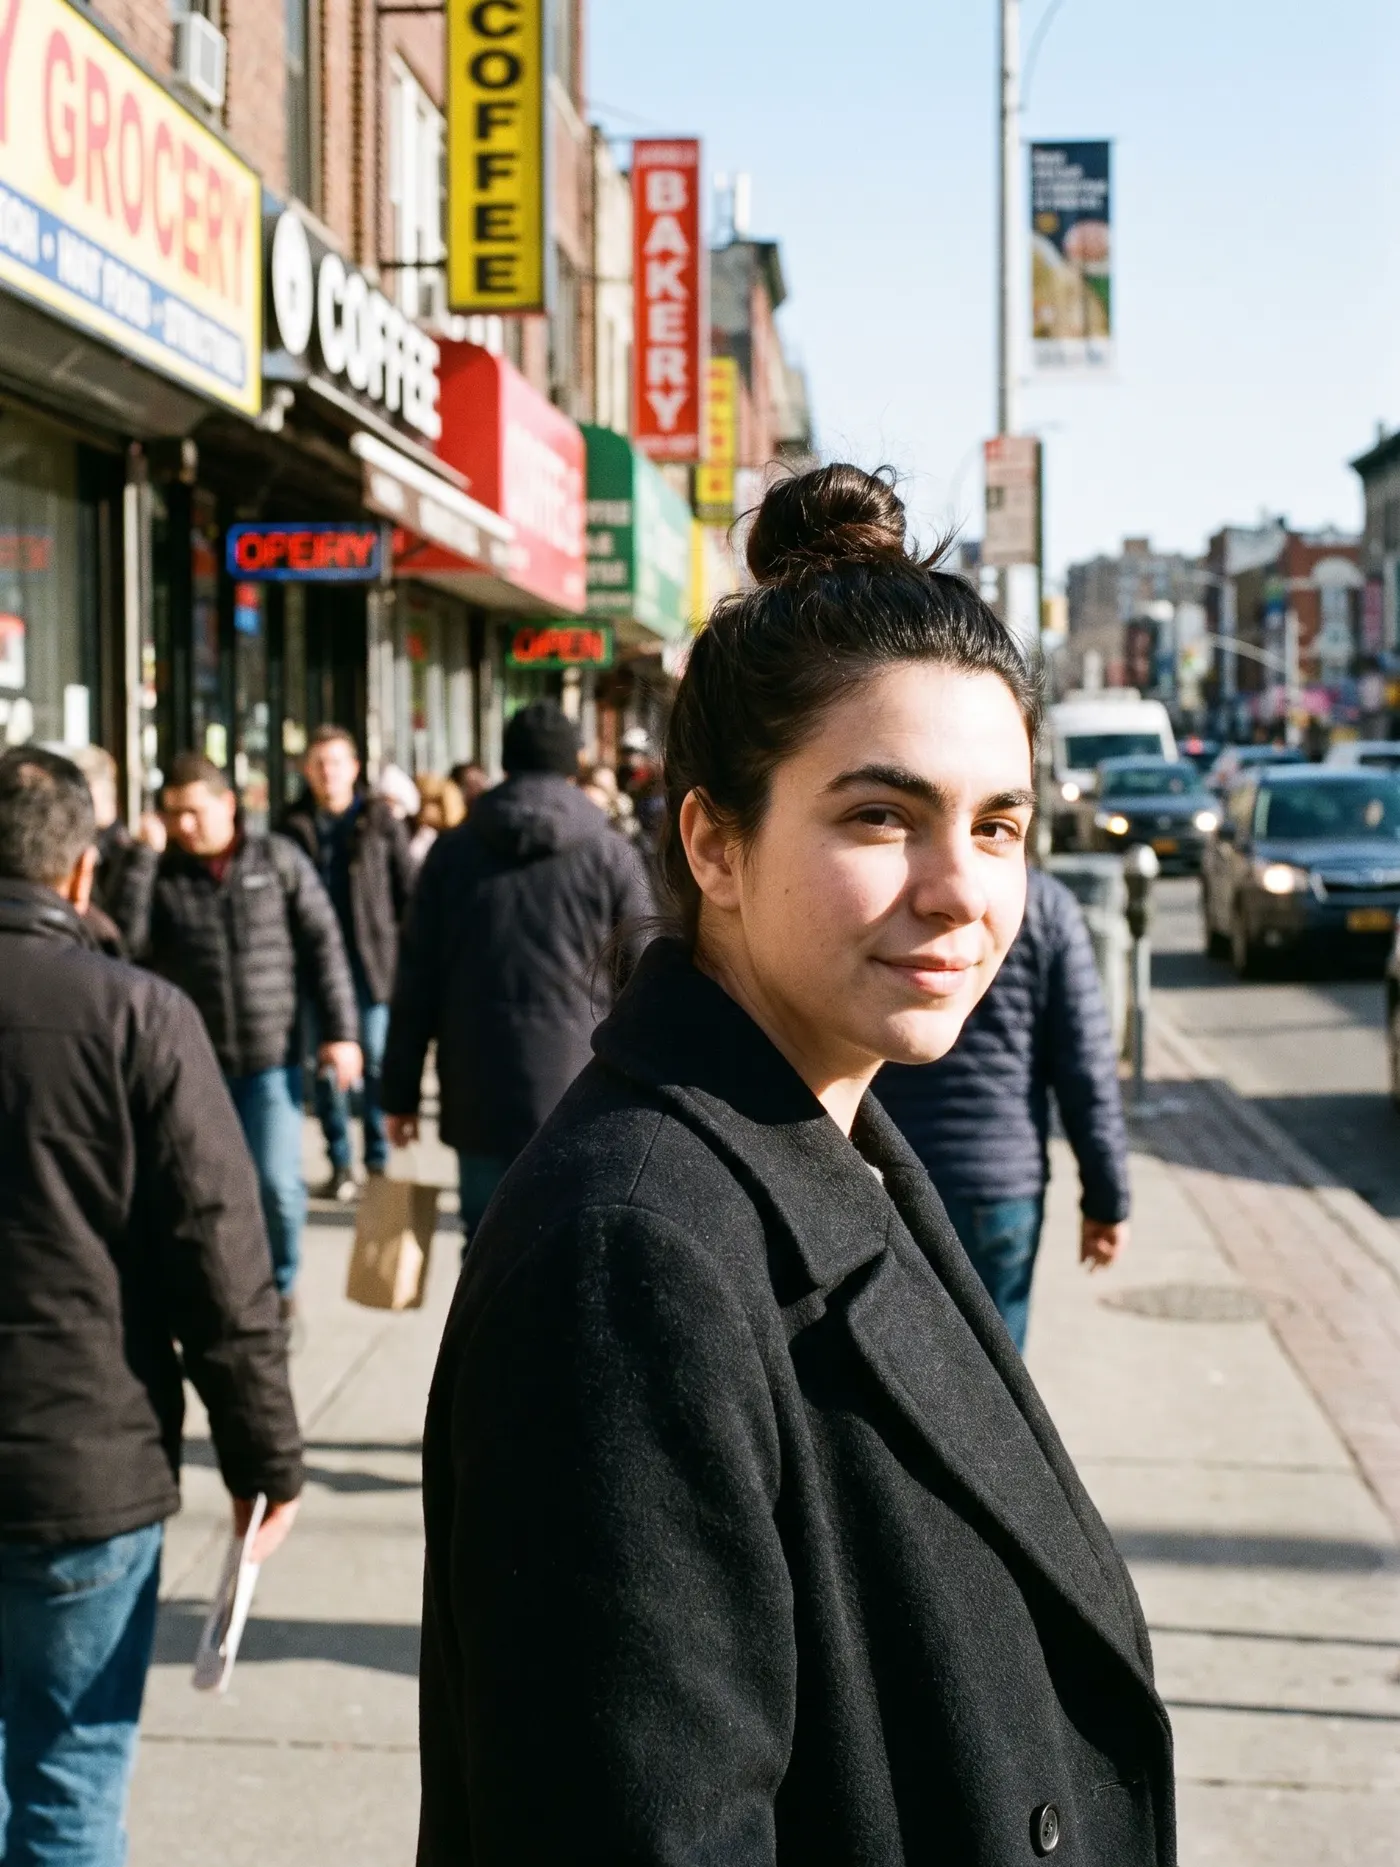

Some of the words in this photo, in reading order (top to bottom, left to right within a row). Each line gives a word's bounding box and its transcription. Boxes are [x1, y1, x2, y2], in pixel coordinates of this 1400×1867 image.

[45, 29, 248, 307] GROCERY
[467, 0, 524, 294] COFFEE
[317, 252, 442, 440] COFFEE
[643, 171, 689, 430] BAKERY
